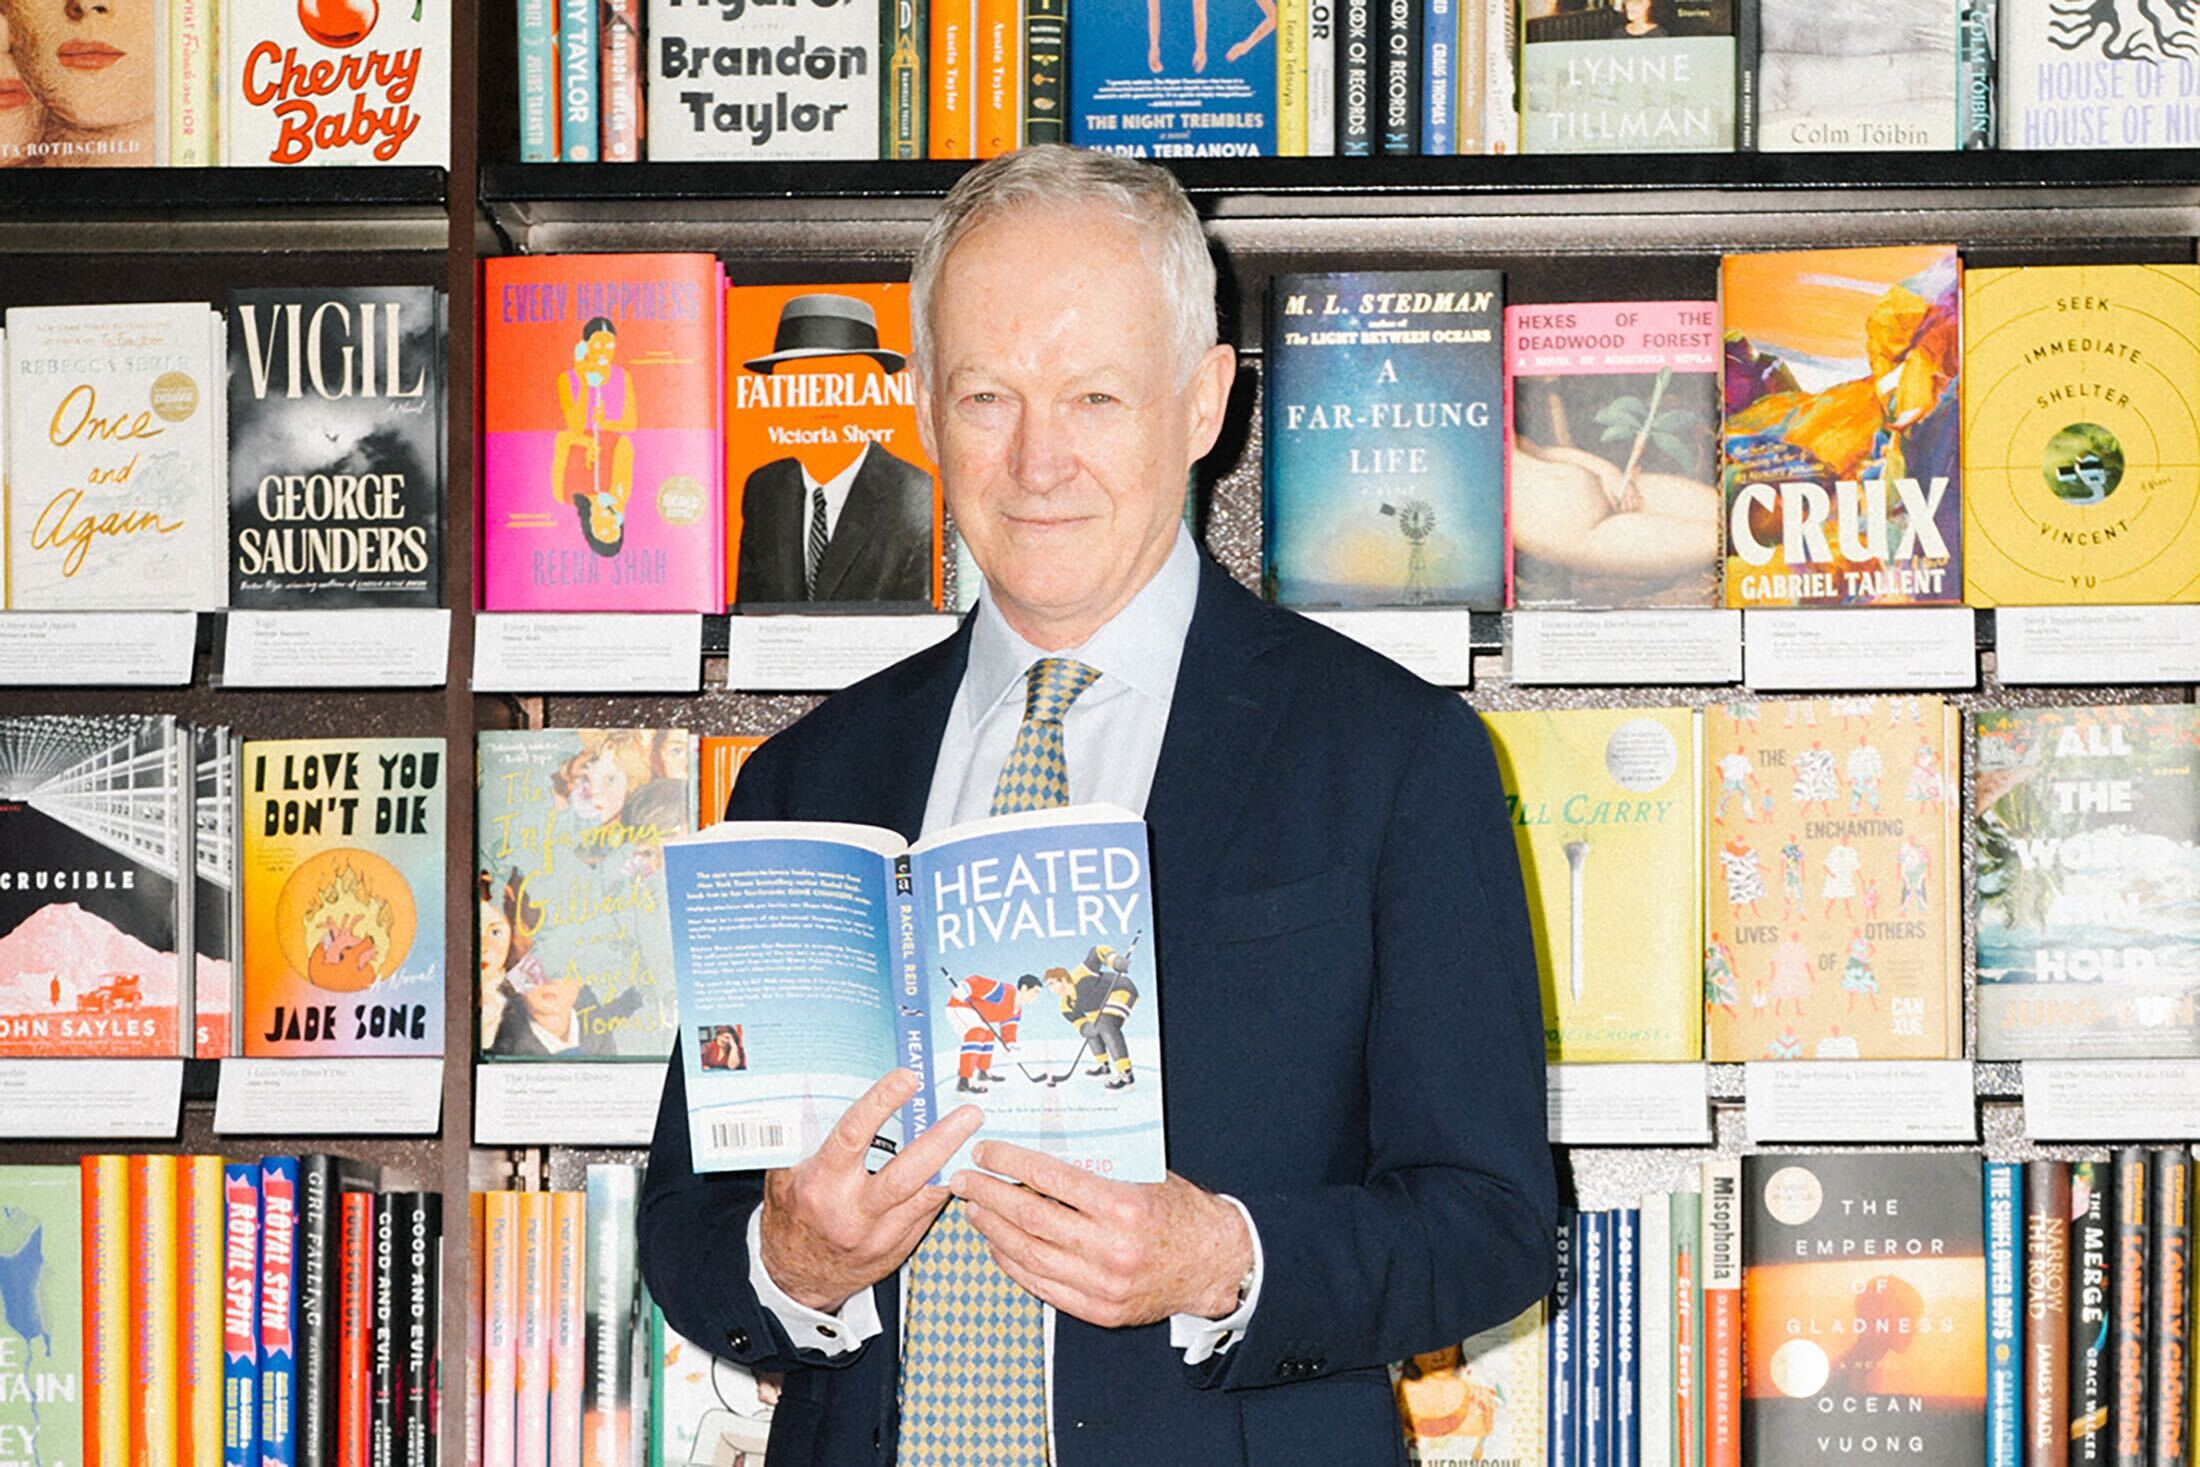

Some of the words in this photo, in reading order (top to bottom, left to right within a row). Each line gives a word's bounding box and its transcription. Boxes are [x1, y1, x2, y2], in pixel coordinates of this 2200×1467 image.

[611, 24, 627, 81] BRANDON
[945, 22, 958, 65] Austin
[992, 21, 1006, 63] Austin
[1286, 18, 1295, 54] Terao
[1349, 43, 1366, 64] OF
[1388, 34, 1408, 56] OF
[1969, 10, 1986, 64] COLM
[242, 40, 422, 106] Cherry
[567, 31, 592, 124] TAYLOR
[661, 36, 867, 79] Brandon
[1432, 43, 1447, 77] CRAIG
[1568, 54, 1690, 86] LYNNE
[943, 70, 957, 112] Taylor
[991, 66, 1005, 110] Taylor
[1285, 58, 1295, 107] Tetsuya
[1348, 69, 1367, 135] RECORDS
[1388, 60, 1407, 127] RECORDS
[1432, 79, 1447, 125] THOMAS
[1970, 68, 1989, 133] TÓIBÍN
[2037, 60, 2123, 102] HOUSE
[2135, 60, 2167, 99] OF
[183, 109, 194, 136] FOR
[269, 93, 421, 164] Baby
[611, 85, 627, 131] TAYLOR
[680, 92, 848, 146] Taylor
[1085, 114, 1118, 131] THE
[1122, 113, 1175, 129] NIGHT
[1180, 112, 1264, 129] TREMBLES
[1547, 108, 1711, 140] TILLMAN
[2024, 109, 2116, 147] HOUSE
[2122, 106, 2156, 145] OF
[27, 140, 140, 156] ROTHSCHILD
[1152, 142, 1260, 158] TERRANOVA
[1791, 123, 1848, 145] Colm
[1857, 124, 1928, 146] Tóibín
[502, 283, 568, 324] EVERY
[576, 280, 700, 321] HAPPINESS
[1284, 295, 1313, 315] M.
[1323, 294, 1349, 315] L.
[1359, 292, 1493, 314] STEDMAN
[1518, 314, 1577, 329] HEXES
[1615, 312, 1639, 328] OF
[1678, 311, 1713, 326] THE
[2057, 296, 2110, 312] SEEK
[238, 301, 426, 400] VIGIL
[1284, 332, 1308, 346] The
[1311, 332, 1358, 345] LIGHT
[1360, 330, 1430, 345] BETWEEN
[1432, 329, 1493, 344] OCEANS
[1518, 334, 1625, 351] DEADWOOD
[1642, 332, 1713, 349] FOREST
[2023, 338, 2143, 365] IMMEDIATE
[1377, 359, 1398, 384] A
[50, 384, 165, 447] Once
[1287, 402, 1490, 430] FAR-FLUNG
[2036, 383, 2130, 410] SHELTER
[767, 425, 838, 445] Victoria
[843, 424, 895, 444] Shorr
[88, 452, 140, 484] and
[1350, 449, 1429, 475] LIFE
[257, 474, 405, 521] GEORGE
[31, 488, 184, 577] Again
[1731, 477, 1950, 567] CRUX
[2039, 520, 2129, 546] VINCENT
[238, 526, 429, 575] SAUNDERS
[533, 550, 600, 586] REENA
[610, 549, 667, 585] SHAH
[1741, 573, 1838, 600] GABRIEL
[1844, 569, 1946, 598] TALLENT
[2070, 575, 2097, 589] YU
[1758, 750, 1787, 767] THE
[2054, 724, 2133, 757] ALL
[254, 755, 266, 792] I
[283, 752, 360, 790] LOVE
[379, 752, 440, 790] YOU
[500, 767, 542, 805] The
[264, 796, 359, 836] DON'T
[375, 794, 428, 835] DIE
[1563, 793, 1674, 826] CARRY
[2053, 779, 2133, 814] THE
[491, 807, 682, 874] Infamous
[1806, 819, 1904, 840] ENCHANTING
[0, 870, 136, 890] CRUCIBLE
[934, 847, 1141, 913] HEATED
[899, 904, 915, 959] RACHEL
[936, 893, 1140, 954] RIVALRY
[1735, 926, 1779, 945] LIVES
[1864, 922, 1927, 941] OTHERS
[903, 962, 918, 997] REID
[1818, 953, 1838, 972] OF
[2036, 949, 2152, 984] HOLD
[264, 1004, 337, 1043] JADE
[355, 1003, 427, 1041] SONG
[1891, 997, 1925, 1017] CAN
[61, 1019, 157, 1038] SAYLES
[307, 1171, 324, 1224] GIRL
[1990, 1167, 2011, 1198] THE
[1842, 1200, 1899, 1215] THE
[2089, 1192, 2101, 1219] THE
[227, 1202, 256, 1271] ROYAL
[265, 1195, 293, 1264] ROYAL
[346, 1204, 361, 1257] FOOLS
[378, 1211, 392, 1270] GOOD
[411, 1209, 426, 1267] GOOD
[1713, 1177, 1736, 1281] Misophonia
[1796, 1239, 1945, 1255] EMPEROR
[1990, 1200, 2012, 1294] SUNFLOWER
[2029, 1212, 2046, 1256] THE
[302, 1232, 323, 1327] FALLING
[346, 1261, 361, 1295] FOR
[1851, 1279, 1889, 1294] OF
[2045, 1218, 2063, 1313] NARROW
[2082, 1227, 2104, 1323] MERGE
[2120, 1235, 2142, 1337] LONELY
[226, 1276, 254, 1338] SPIN
[262, 1270, 290, 1331] SPIN
[377, 1276, 391, 1321] AND
[410, 1273, 425, 1318] AND
[2028, 1260, 2046, 1320] ROAD
[2161, 1237, 2183, 1337] LONELY
[345, 1299, 361, 1339] LOVE
[1717, 1294, 1729, 1341] DANA
[1786, 1317, 1954, 1334] GLADNESS
[1991, 1297, 2013, 1340] BOYS
[376, 1327, 391, 1375] EVIL
[409, 1325, 425, 1373] EVIL
[2036, 1343, 2053, 1393] JAMES
[2085, 1347, 2098, 1397] GRACE
[1818, 1397, 1923, 1413] OCEAN
[2118, 1339, 2141, 1457] CROWDS
[2159, 1342, 2182, 1458] CROWDS
[1817, 1436, 1924, 1452] VUONG
[2037, 1398, 2053, 1449] WADE
[2084, 1400, 2097, 1460] WALKER
